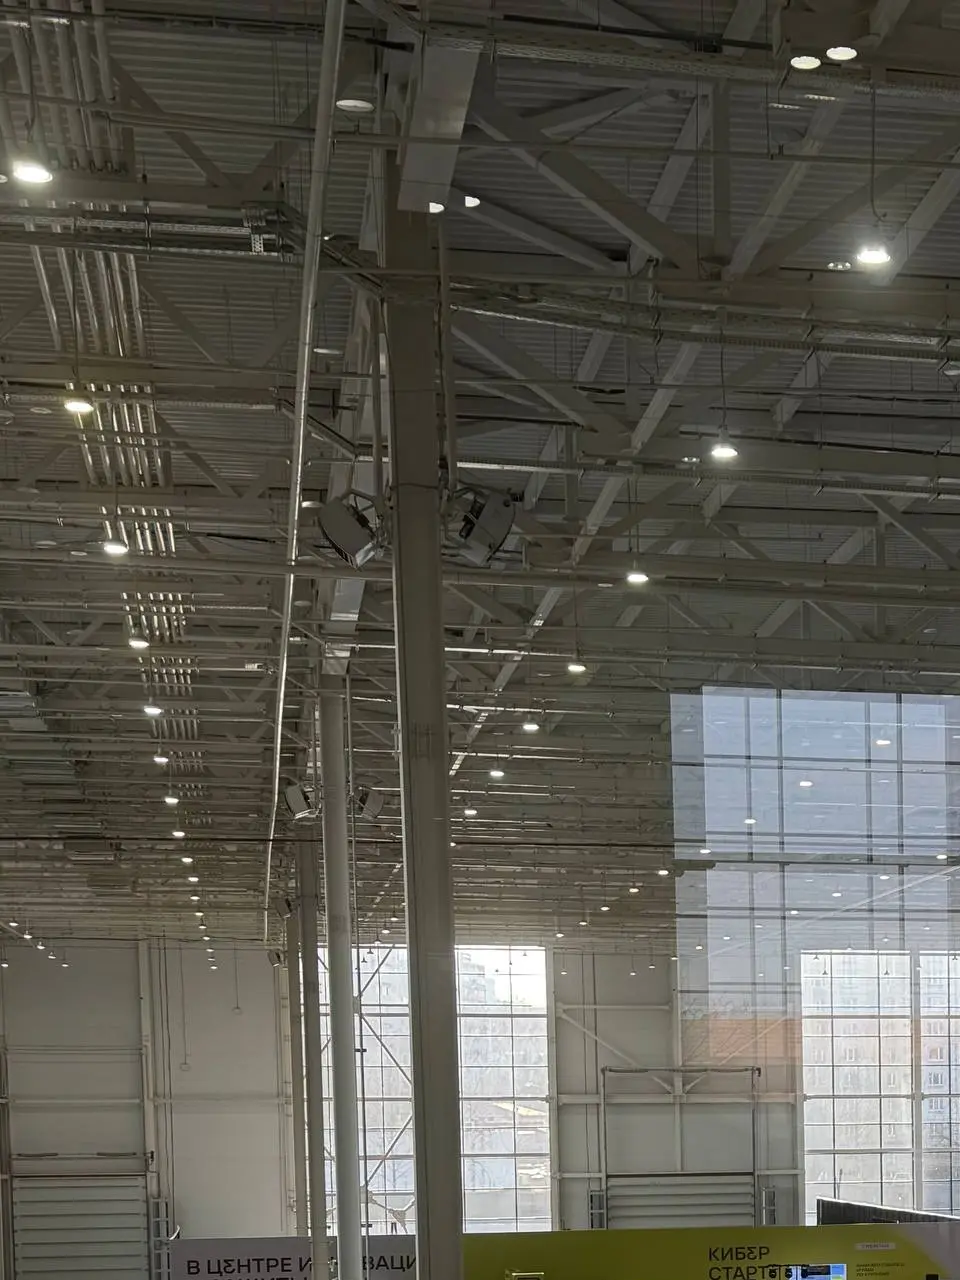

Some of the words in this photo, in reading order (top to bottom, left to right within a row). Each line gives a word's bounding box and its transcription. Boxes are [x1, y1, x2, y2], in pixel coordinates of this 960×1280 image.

[709, 1246, 770, 1261] КИБЕР
[187, 1260, 200, 1275] В
[207, 1257, 292, 1277] ЦЕНТРЕ
[709, 1265, 770, 1280] СТАРТ
